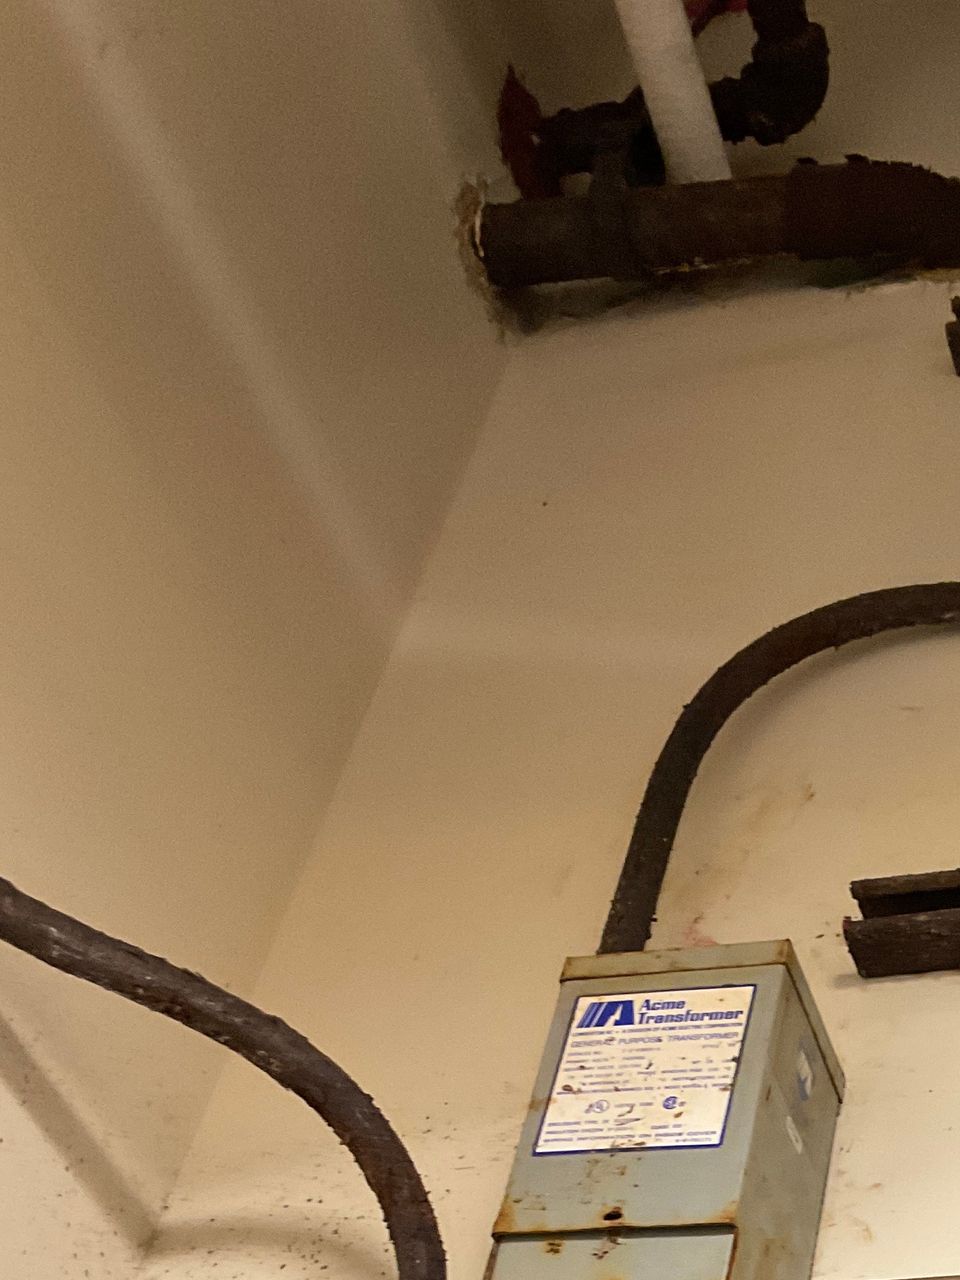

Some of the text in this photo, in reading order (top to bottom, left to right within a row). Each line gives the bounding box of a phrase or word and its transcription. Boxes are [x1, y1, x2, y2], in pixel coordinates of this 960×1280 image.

[640, 999, 686, 1011] Acme
[638, 1010, 744, 1024] Transformer
[668, 1032, 739, 1042] TRANSFORMER
